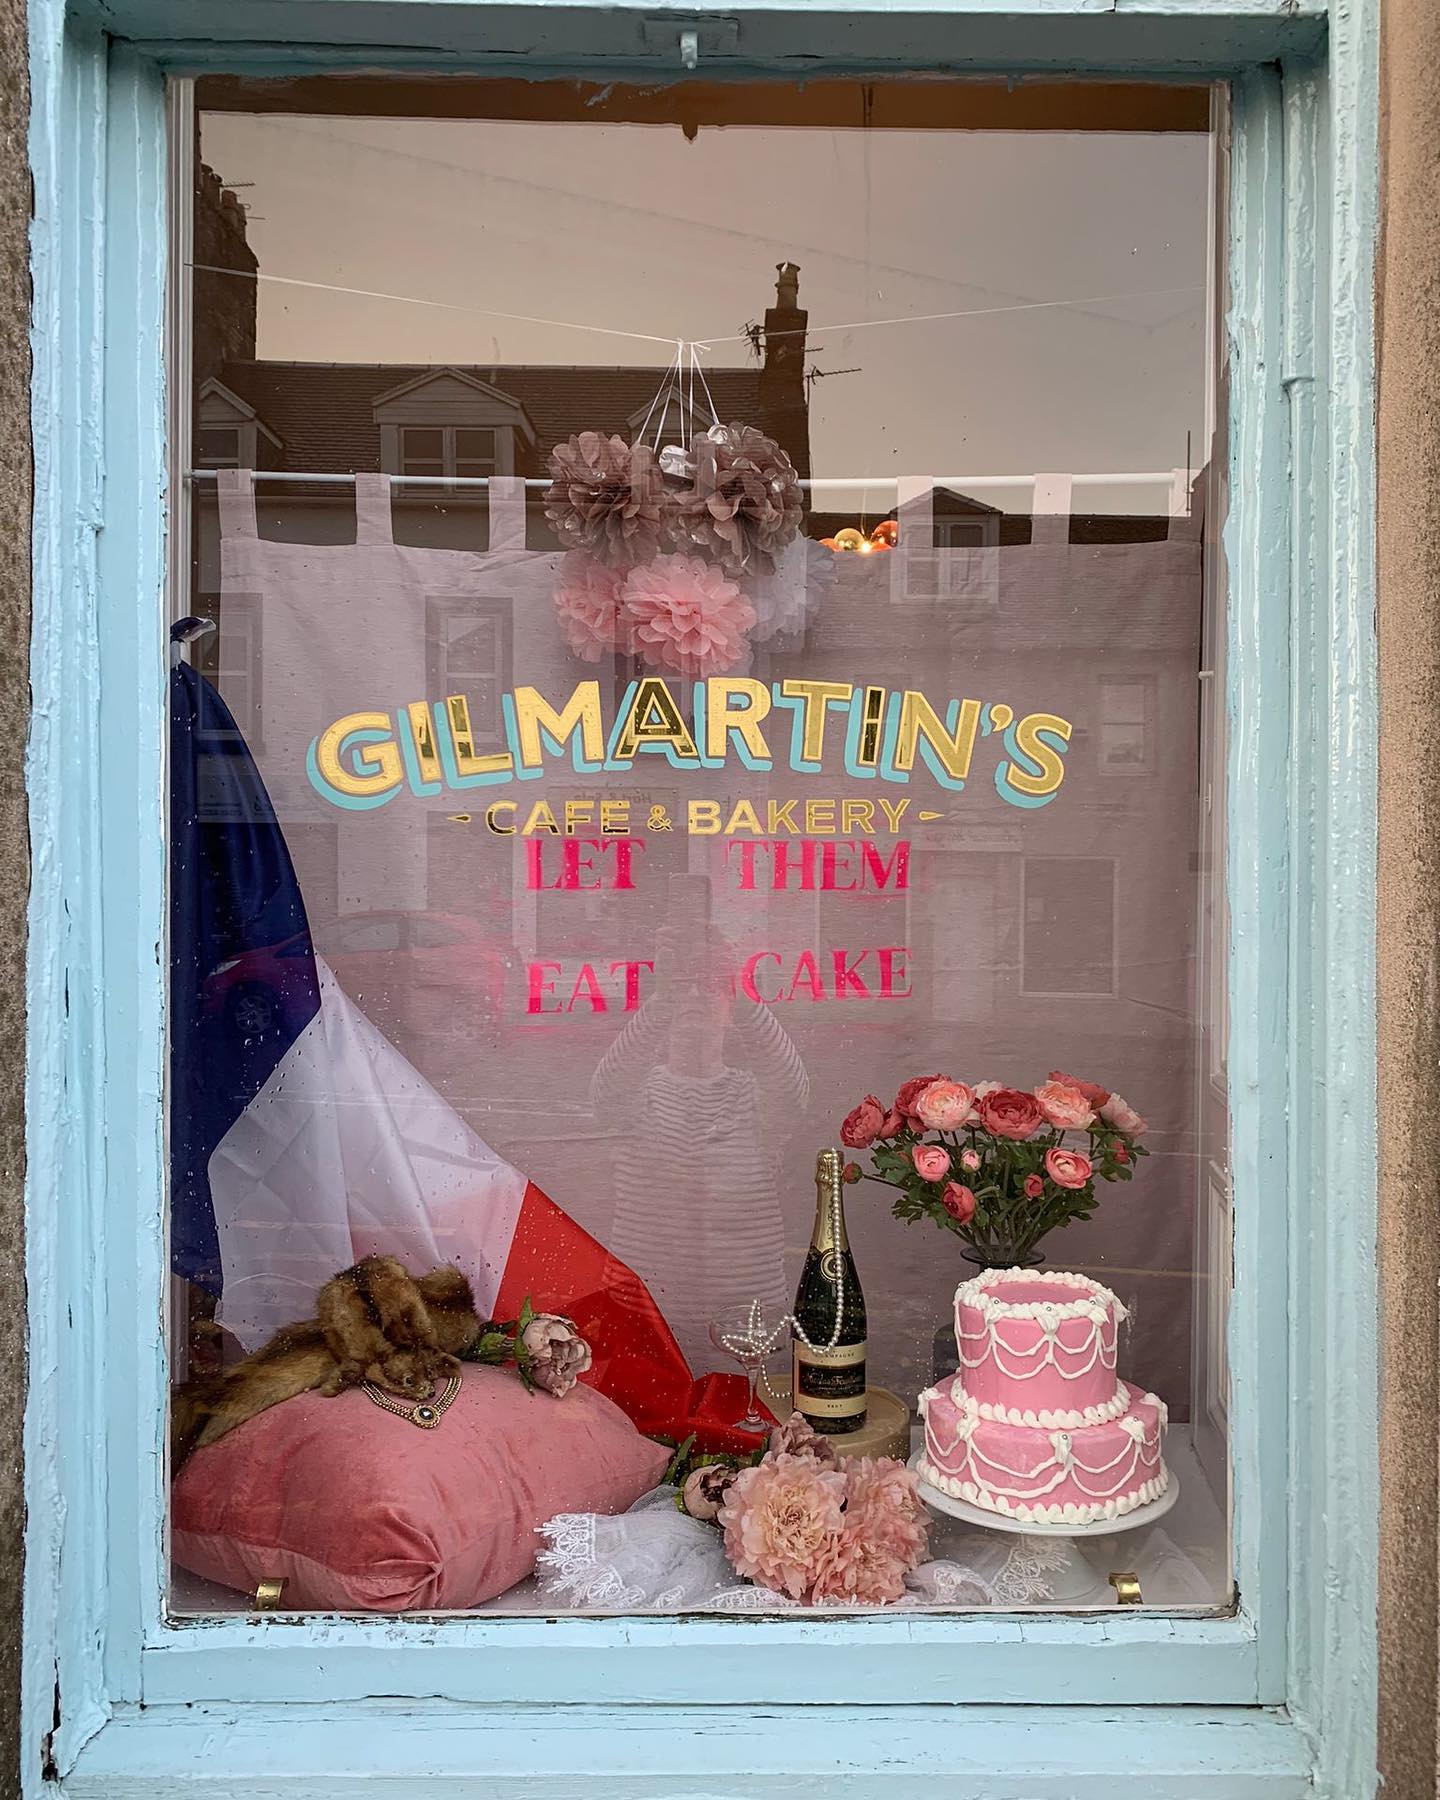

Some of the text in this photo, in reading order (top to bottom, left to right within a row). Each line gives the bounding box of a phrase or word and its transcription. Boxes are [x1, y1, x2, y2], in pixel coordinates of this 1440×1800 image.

[307, 677, 1073, 809] GILMARTIN’S
[485, 799, 631, 836] CAFE
[647, 804, 674, 832] &
[687, 798, 911, 835] BAKERY
[524, 838, 911, 891] LET THEM
[525, 947, 913, 1014] EAT CAKE
